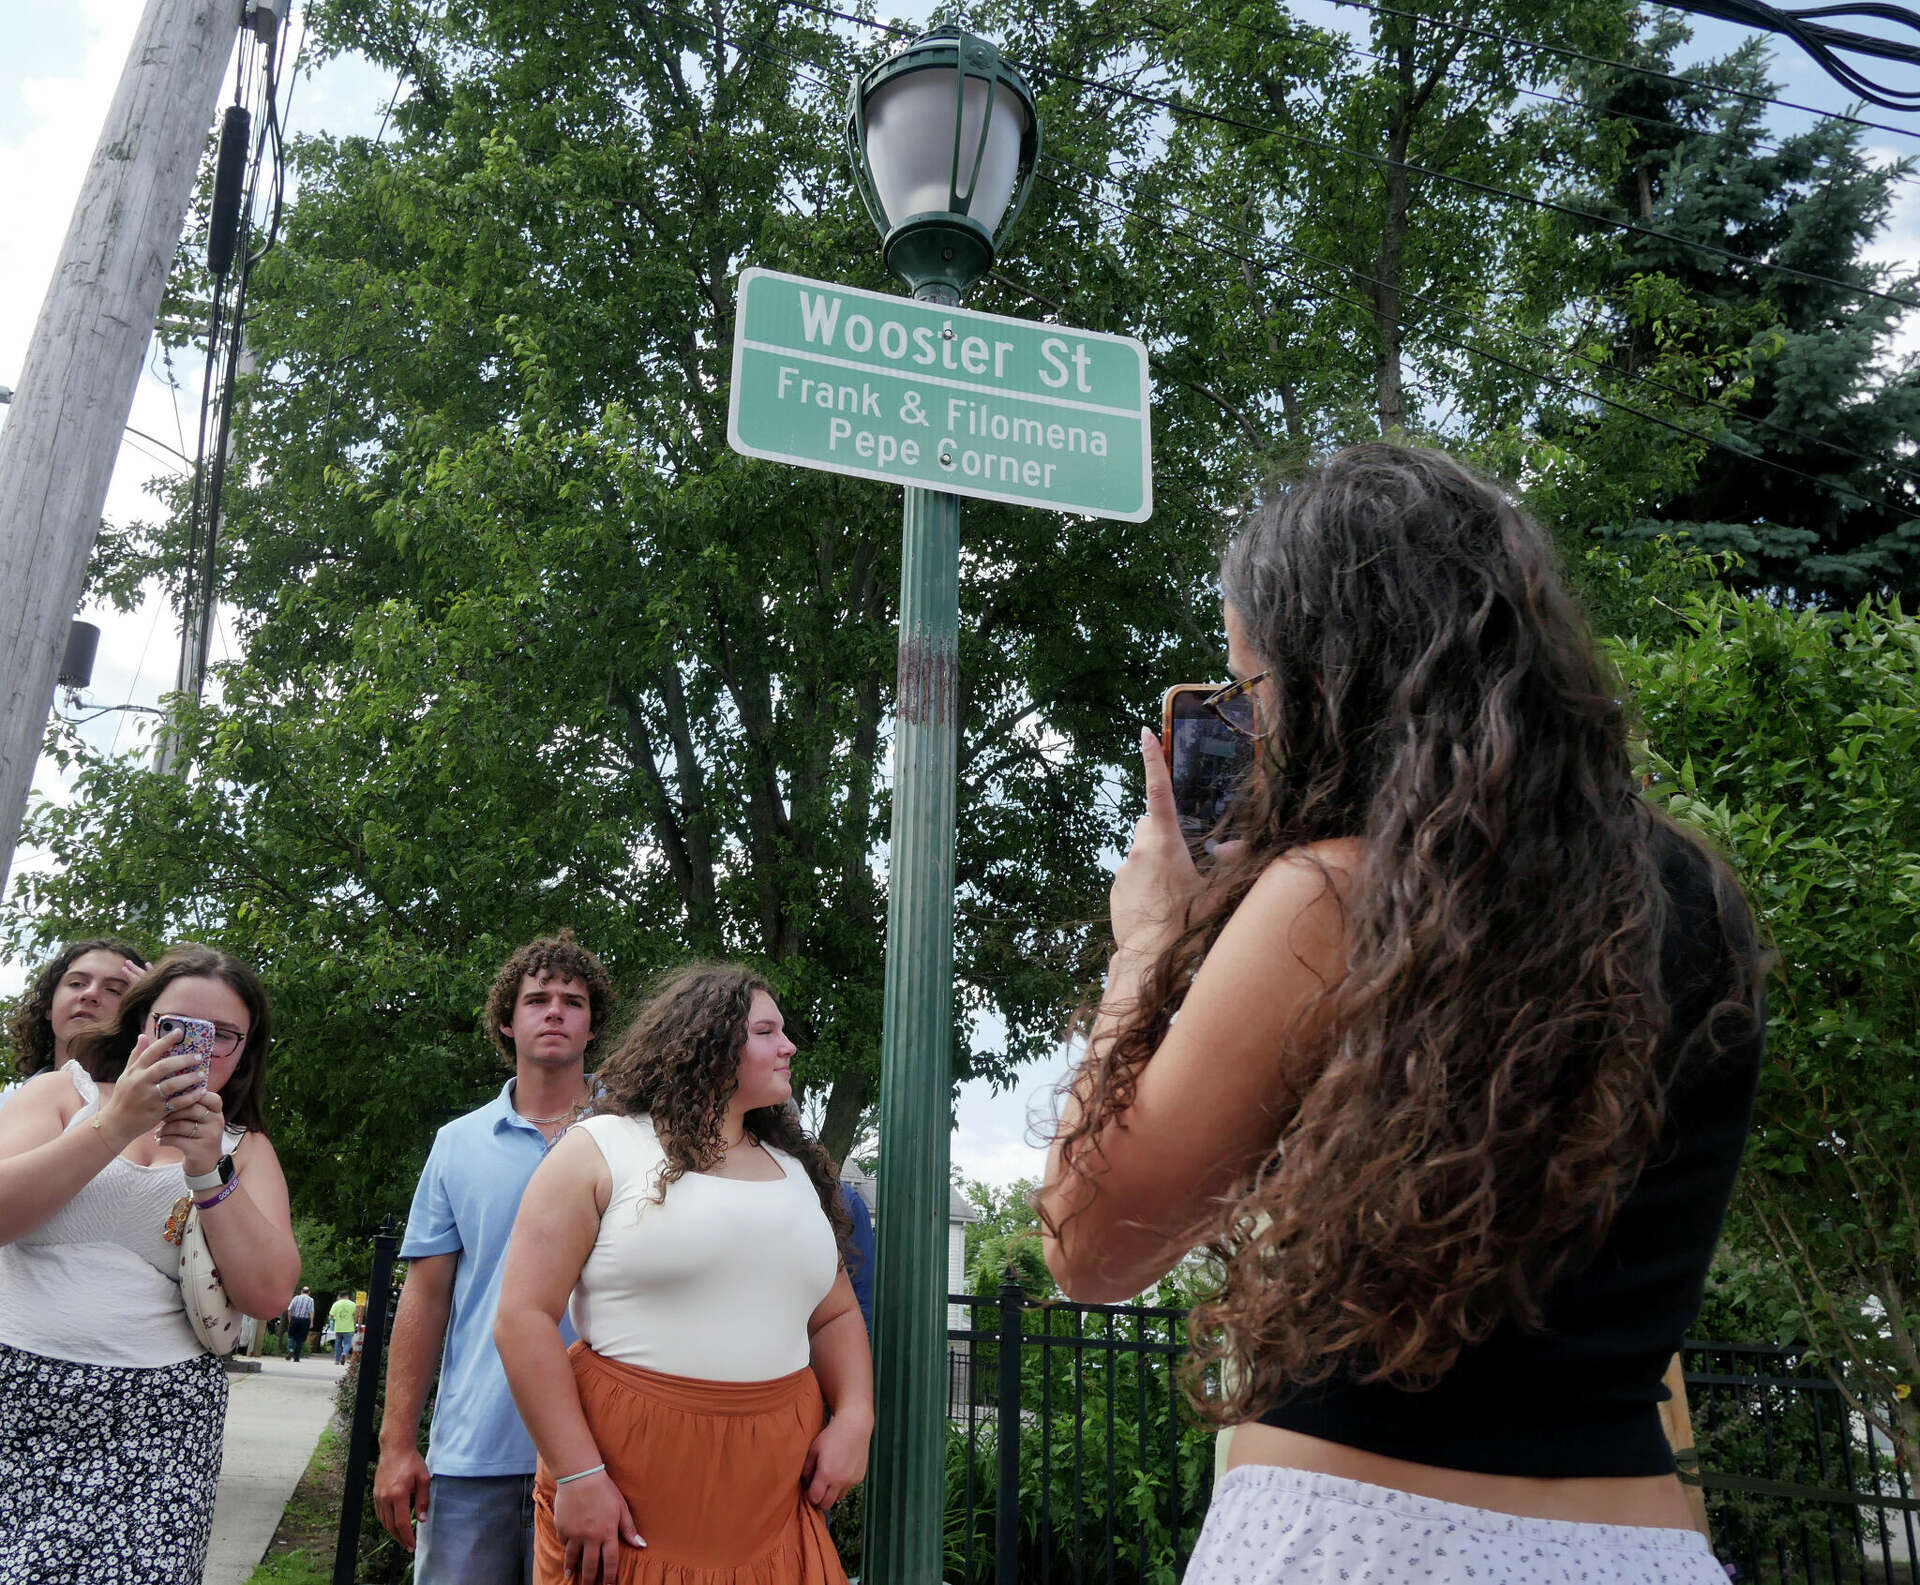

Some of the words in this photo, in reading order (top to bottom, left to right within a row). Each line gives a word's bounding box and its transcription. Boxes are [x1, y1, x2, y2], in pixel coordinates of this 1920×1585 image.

[799, 291, 1014, 378] Wooster
[1038, 338, 1092, 393] St
[777, 366, 882, 417] Frank
[900, 390, 929, 427] &
[947, 398, 1108, 457] Filomena
[829, 417, 920, 468] Pepe
[937, 438, 1057, 489] Corner
